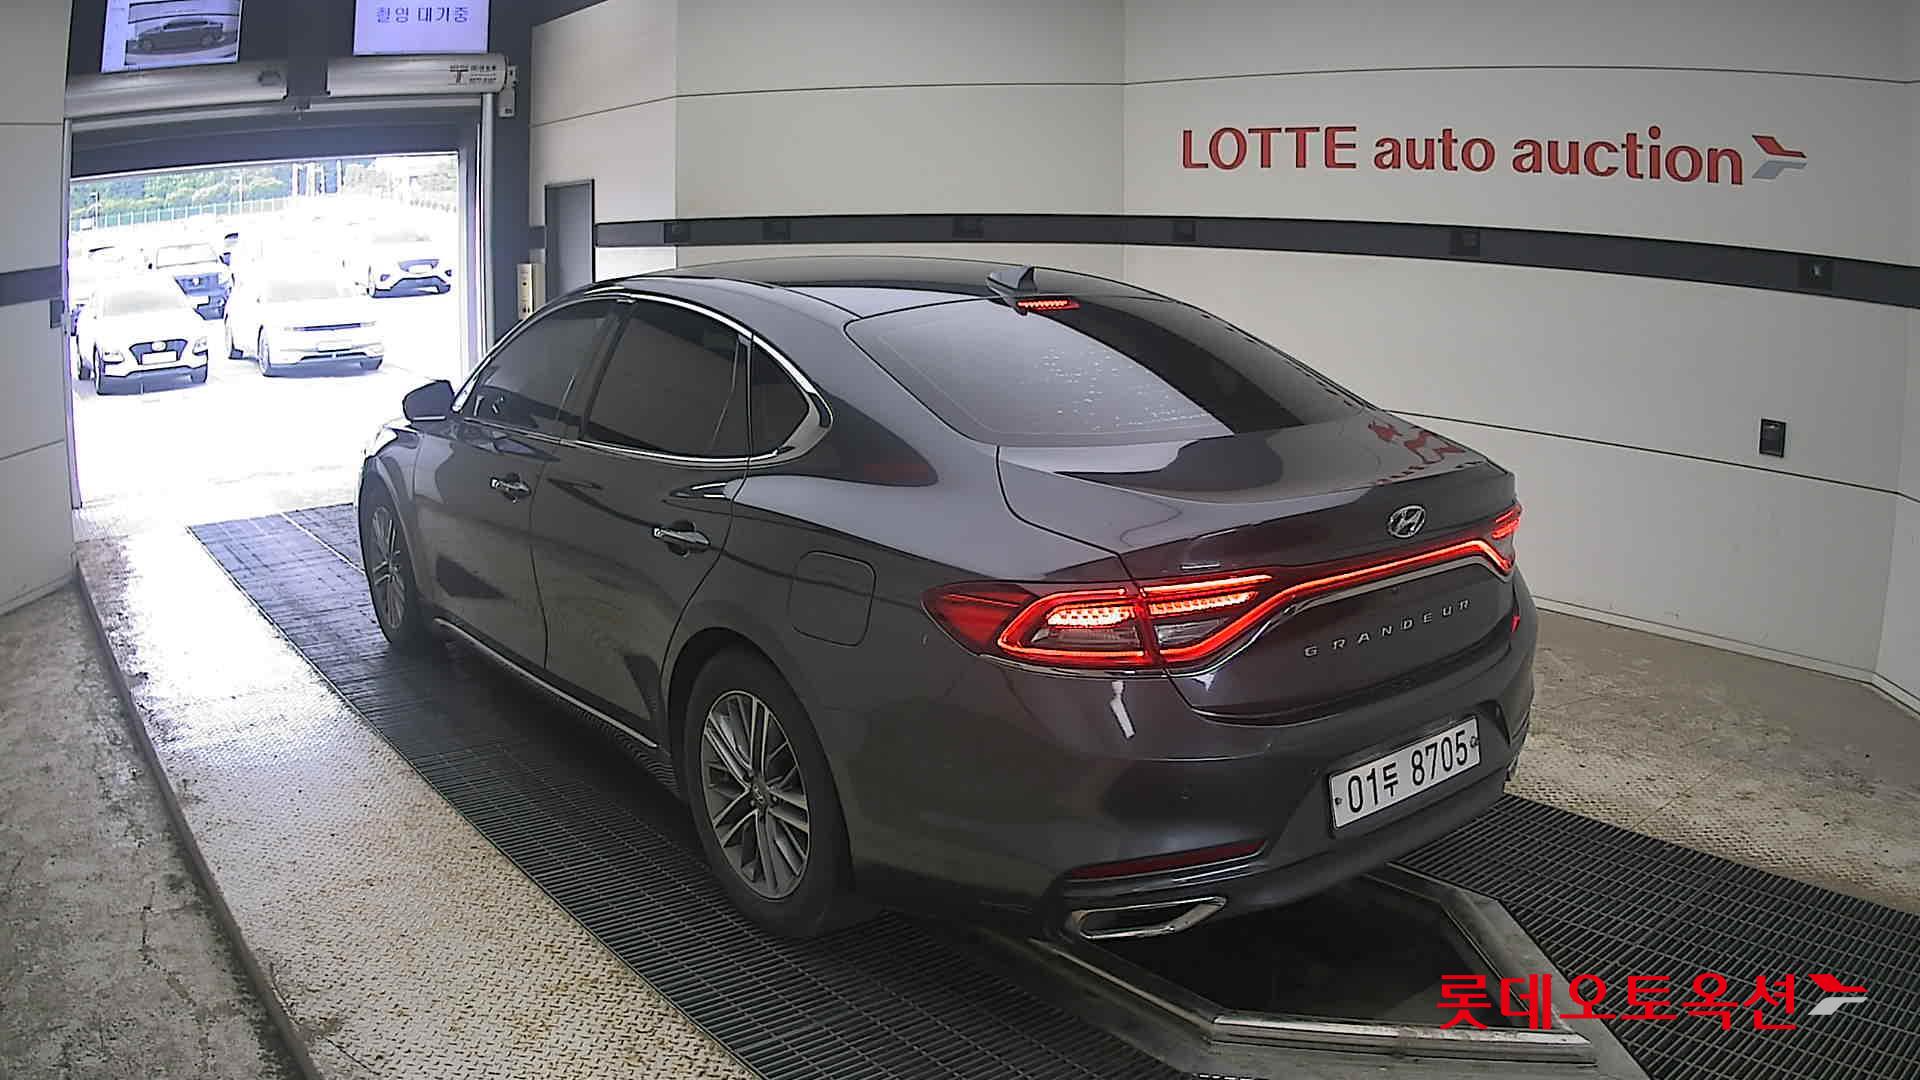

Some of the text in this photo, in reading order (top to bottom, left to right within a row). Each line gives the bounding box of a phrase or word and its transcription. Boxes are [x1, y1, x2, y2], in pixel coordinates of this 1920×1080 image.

[1182, 125, 1743, 185] LOTTE auto auction
[1303, 598, 1471, 658] GRANDEUR
[1346, 730, 1468, 814] 01두 8705
